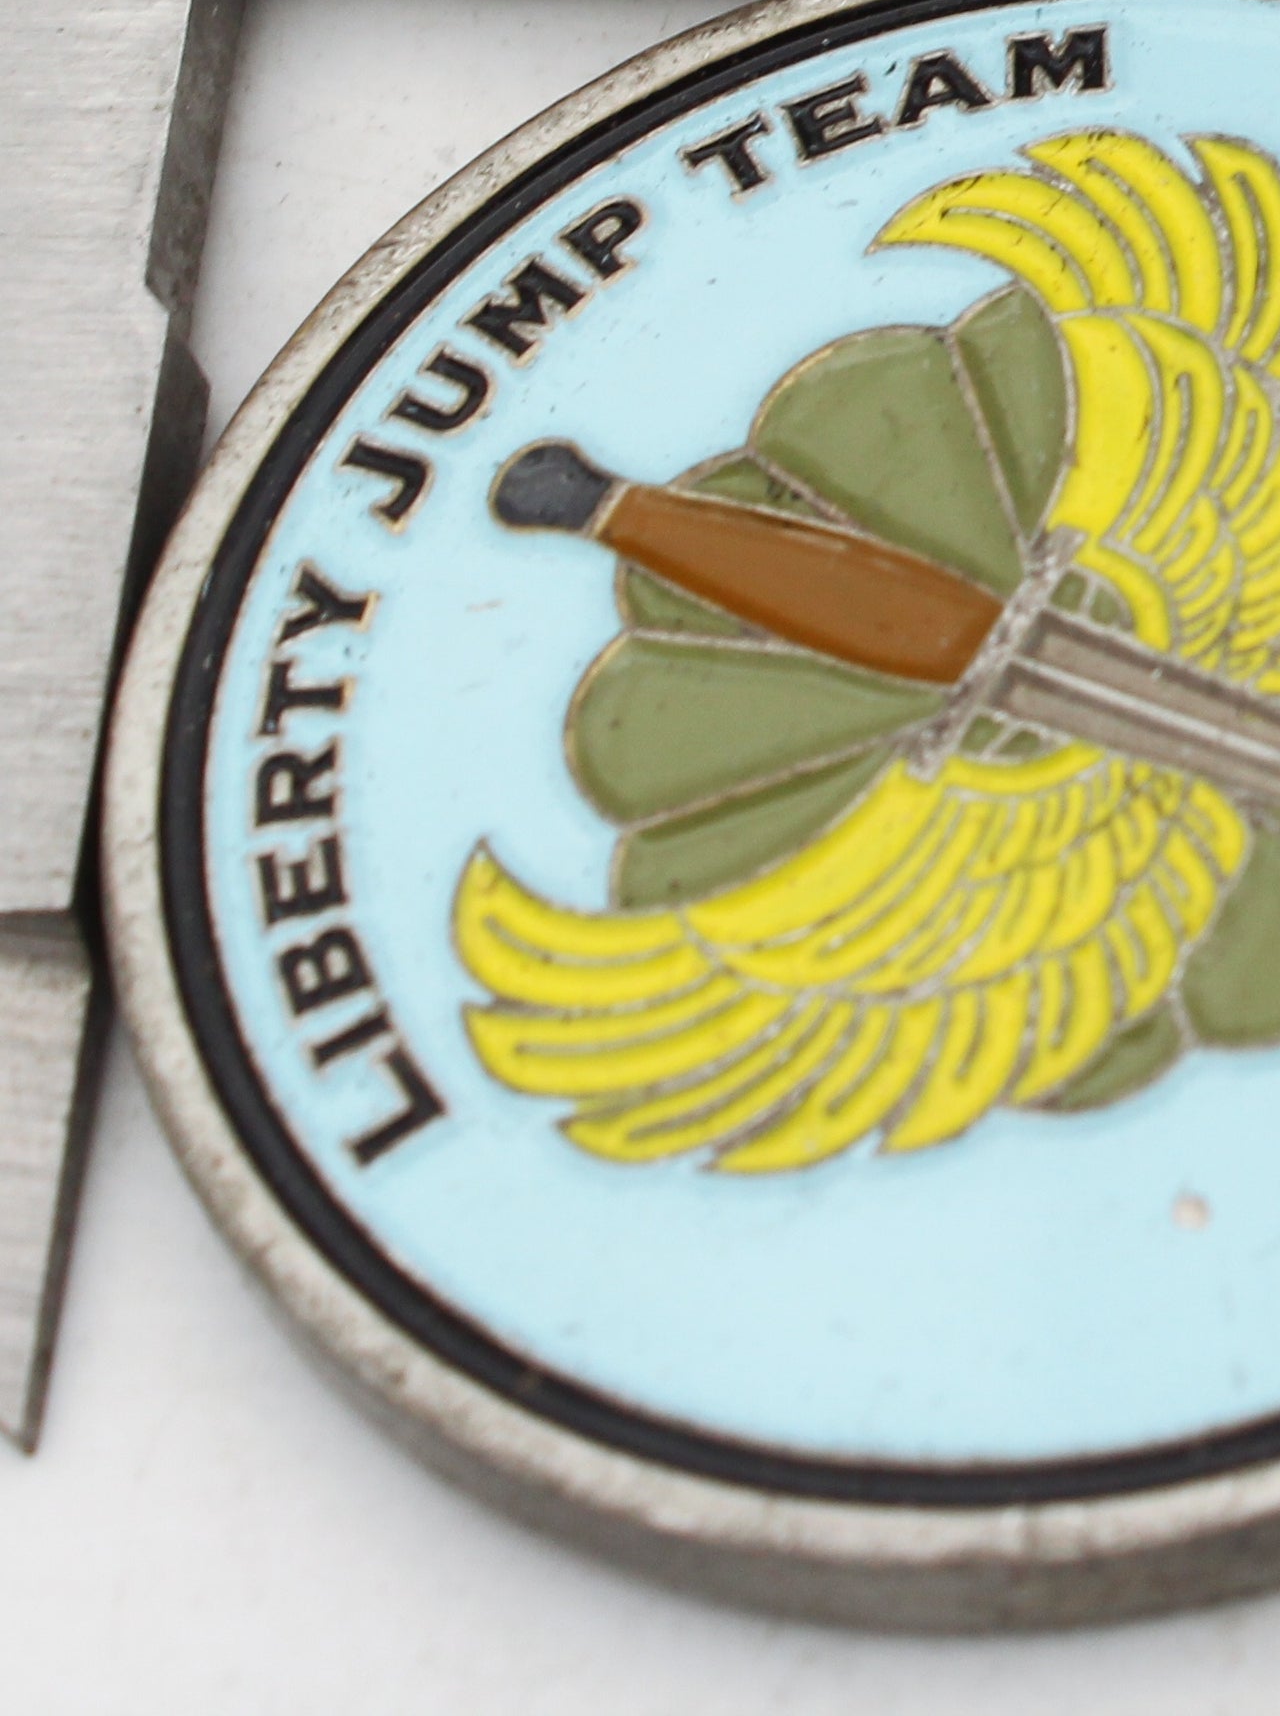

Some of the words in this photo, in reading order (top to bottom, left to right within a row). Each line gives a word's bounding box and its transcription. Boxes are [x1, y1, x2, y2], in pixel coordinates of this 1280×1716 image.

[683, 23, 1110, 198] TEAM
[341, 198, 648, 531] JUMP
[255, 562, 445, 1166] LIBERTY
